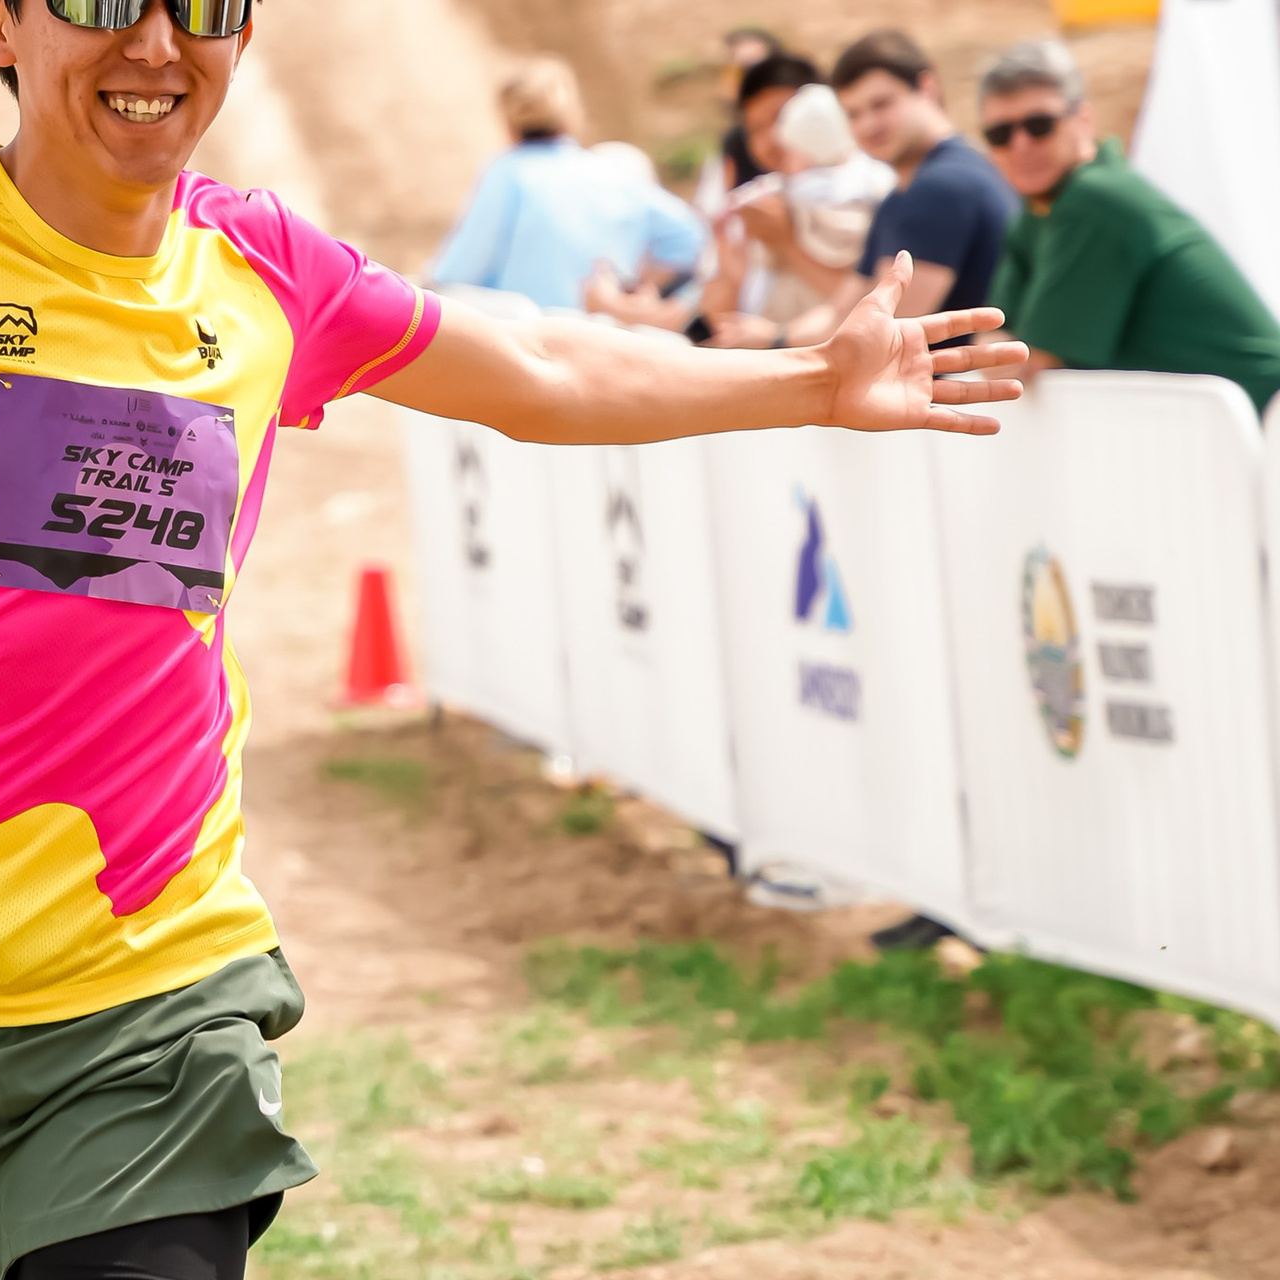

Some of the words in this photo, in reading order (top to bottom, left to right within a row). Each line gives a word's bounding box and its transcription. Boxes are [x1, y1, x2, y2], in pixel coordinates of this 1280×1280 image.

[61, 445, 123, 466] SKY
[127, 453, 194, 477] CAMP
[41, 492, 205, 550] 5248
